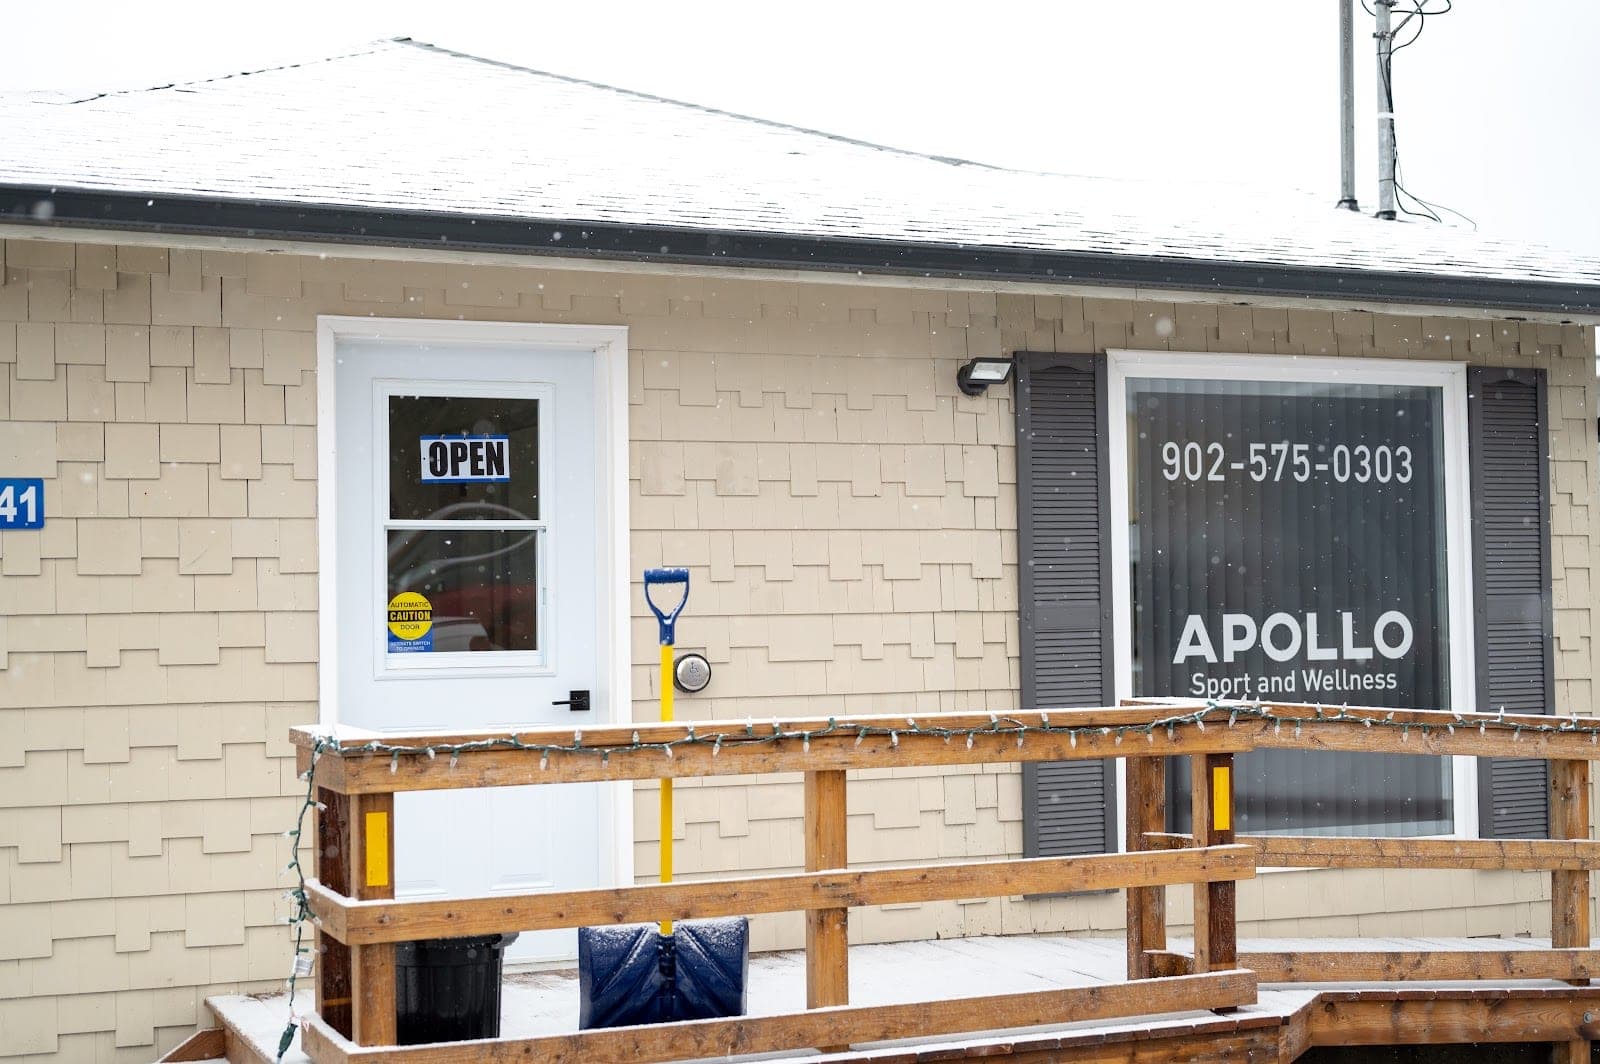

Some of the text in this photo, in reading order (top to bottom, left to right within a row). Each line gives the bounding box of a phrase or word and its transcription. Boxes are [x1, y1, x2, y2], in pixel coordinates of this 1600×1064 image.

[429, 441, 505, 477] OPEN
[1162, 441, 1413, 483] 902-575-0303
[0, 486, 36, 522] 41
[390, 611, 431, 621] CAUTION
[1172, 610, 1414, 664] APOLLO
[1191, 669, 1398, 698] Sport and Wellness
